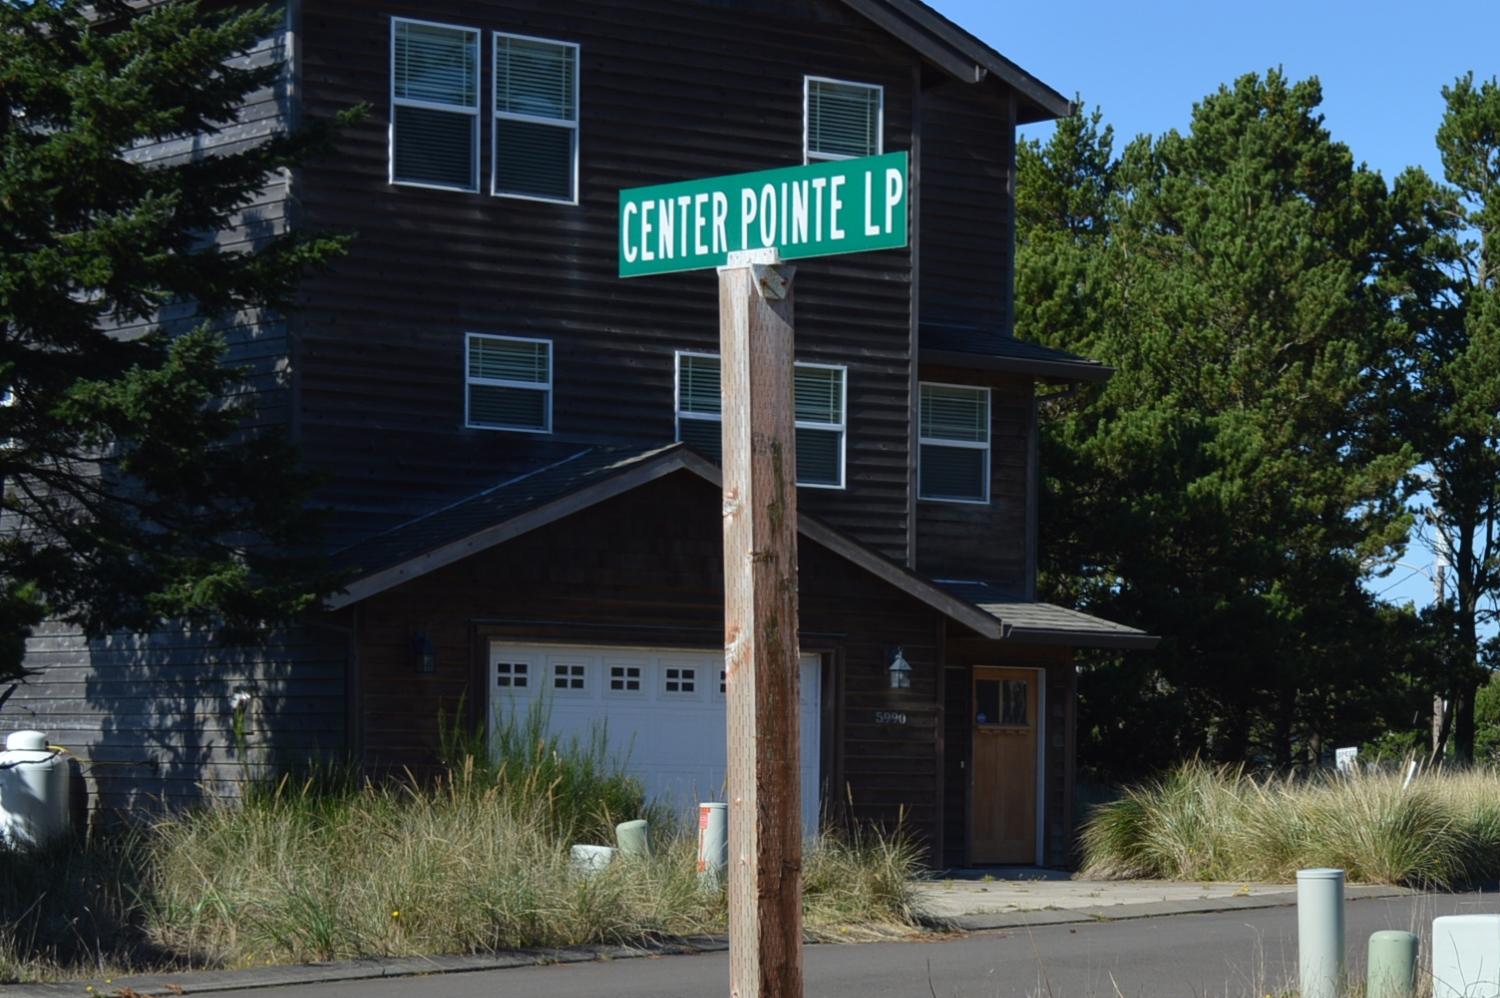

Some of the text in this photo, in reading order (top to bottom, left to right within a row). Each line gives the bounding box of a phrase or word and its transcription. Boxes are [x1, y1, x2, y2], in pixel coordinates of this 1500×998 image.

[622, 168, 903, 264] CENTER POINTE LP
[875, 711, 907, 725] 5990
